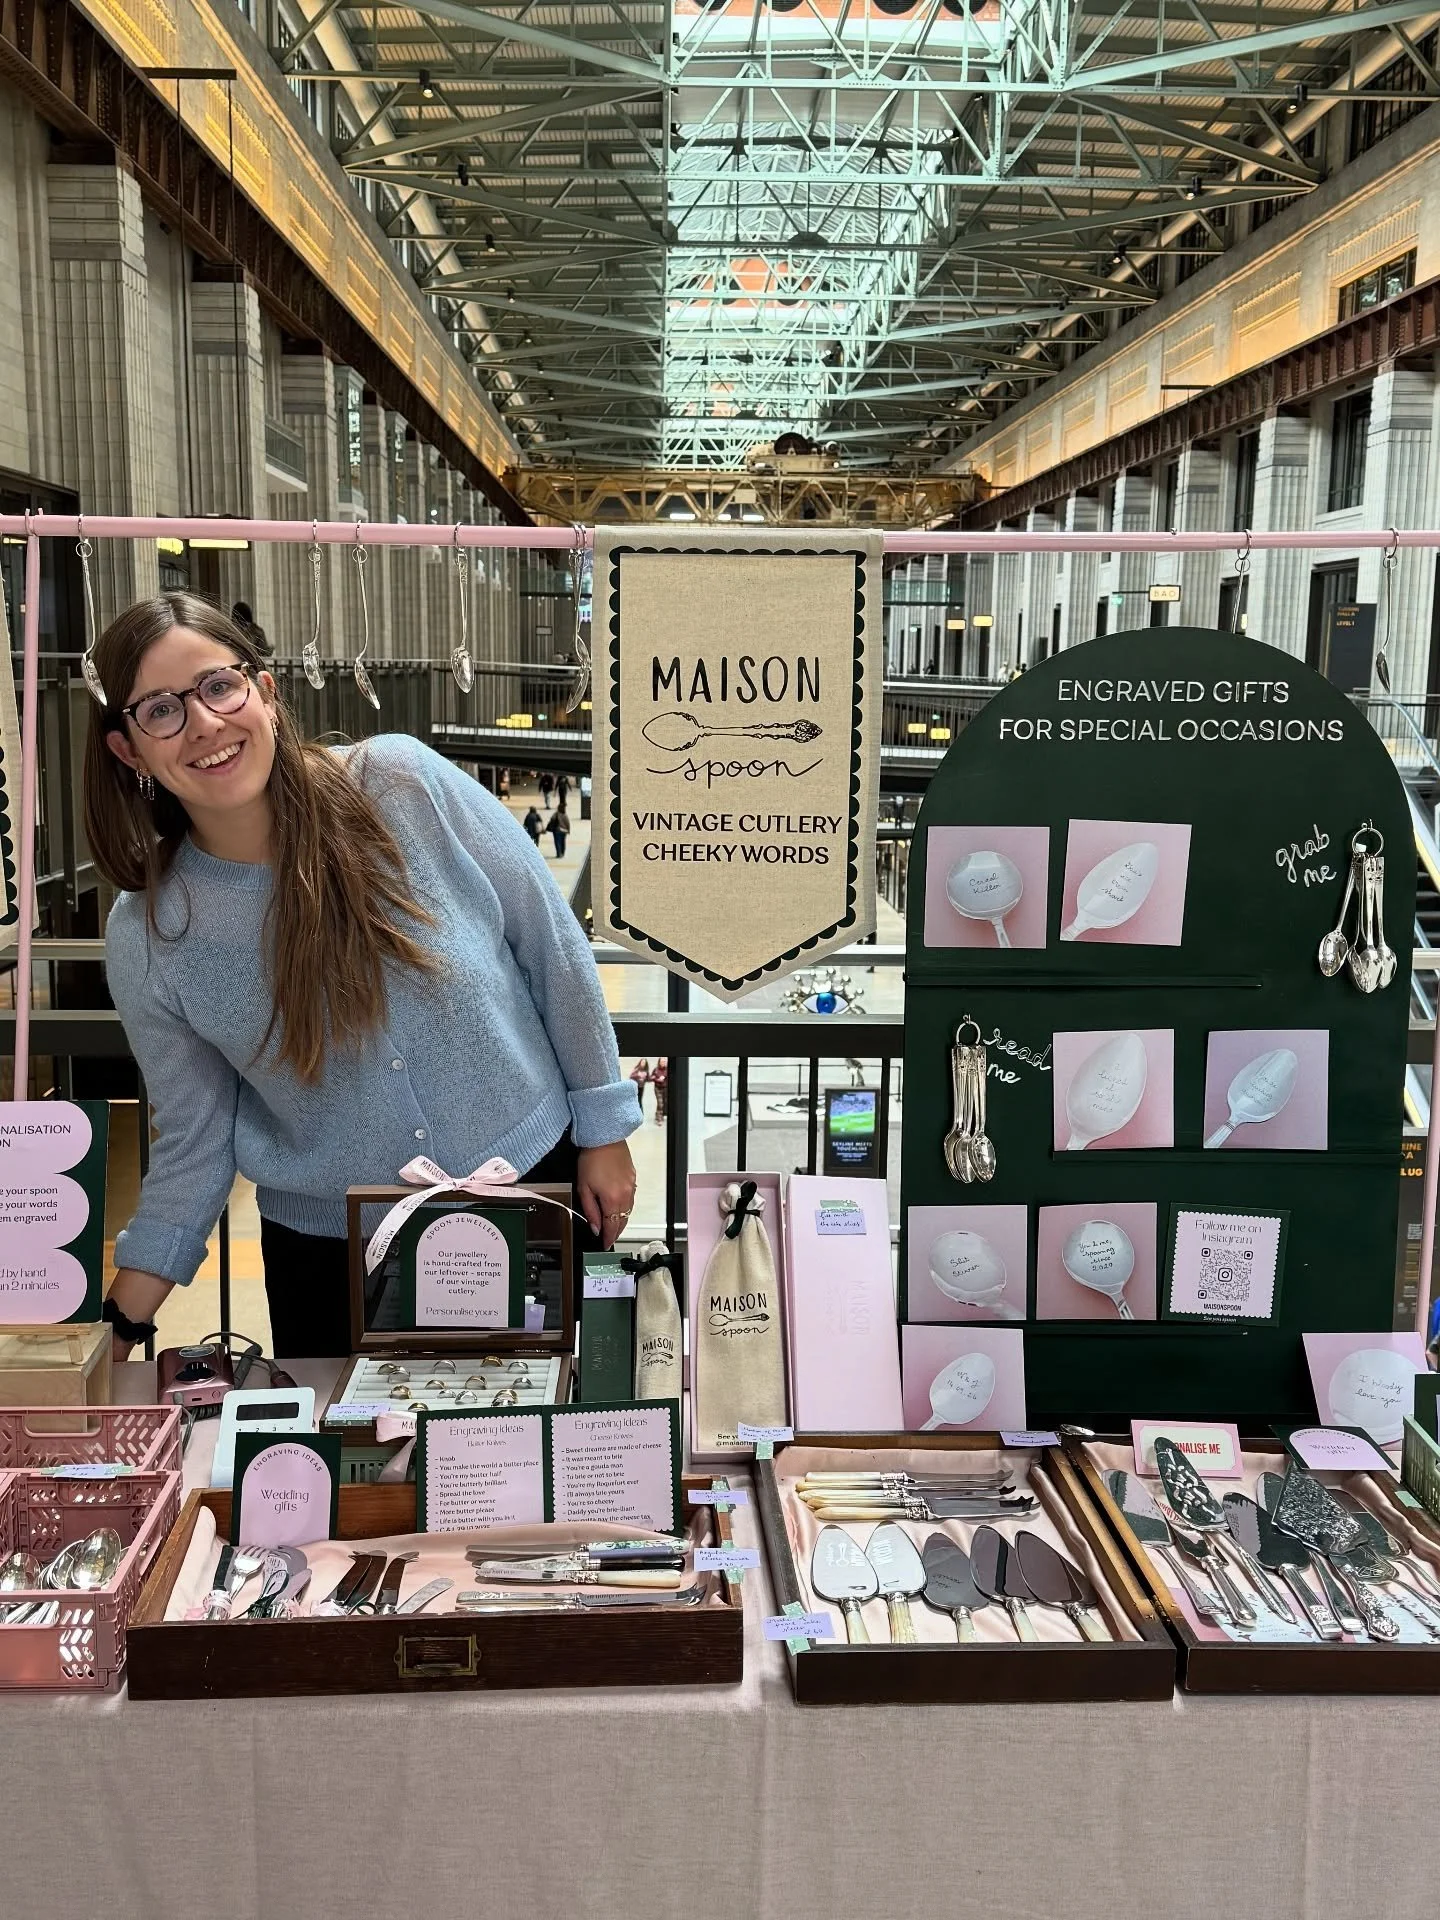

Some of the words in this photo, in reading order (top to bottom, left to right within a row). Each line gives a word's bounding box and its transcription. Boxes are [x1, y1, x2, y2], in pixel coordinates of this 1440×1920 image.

[652, 656, 820, 703] MAISON
[1058, 679, 1205, 702] ENGRAVED
[1212, 681, 1290, 703] GIFTS
[999, 718, 1052, 741] FOR
[1059, 718, 1172, 741] SPECIAL
[1177, 719, 1344, 742] OCCASIONS
[646, 757, 824, 789] spoon
[632, 812, 733, 832] VINTAGE
[739, 814, 843, 834] CUTLERY
[642, 843, 738, 862] CHEEKY
[740, 845, 830, 865] WORDS
[1275, 824, 1330, 883] grab
[1303, 865, 1338, 888] me
[983, 1028, 1052, 1071] read
[987, 1063, 1021, 1084] me
[1, 1124, 71, 1135] NALISATION
[6, 1188, 28, 1198] your
[30, 1187, 58, 1196] spoon
[6, 1202, 27, 1211] your
[30, 1199, 58, 1208] words
[14, 1212, 57, 1224] engraved
[426, 1219, 452, 1241] SPOON
[455, 1217, 500, 1241] JEWELLERY
[1195, 1219, 1228, 1231] Follow
[1229, 1223, 1246, 1233] me
[1248, 1225, 1262, 1233] on
[1202, 1232, 1253, 1246] Instagram
[438, 1250, 453, 1258] Our
[454, 1251, 488, 1260] jewellery
[484, 1260, 502, 1268] from
[7, 1268, 19, 1280] by
[21, 1268, 47, 1278] hand
[11, 1281, 20, 1291] 2
[461, 1279, 489, 1287] vintage
[448, 1288, 477, 1296] cutlery.
[710, 1292, 767, 1312] MAISON
[1203, 1303, 1242, 1311] MAISONSPOON
[425, 1306, 474, 1316] Personalise
[474, 1308, 499, 1318] yours
[710, 1327, 769, 1339] spoon
[642, 1337, 674, 1353] MAISON
[640, 1359, 674, 1368] spoon
[449, 1425, 498, 1438] Engraving
[500, 1423, 524, 1433] Ideas
[574, 1419, 622, 1432] Engraving
[623, 1417, 648, 1427] Ideas
[1209, 1443, 1221, 1455] ME
[253, 1448, 300, 1471] ENGRAVING
[301, 1452, 323, 1472] IDEAS
[523, 1460, 539, 1469] place
[261, 1489, 310, 1503] Wedding
[440, 1491, 461, 1499] Spread
[274, 1500, 298, 1514] gifts
[475, 1507, 495, 1515] please
[567, 1508, 587, 1516] Daddy
